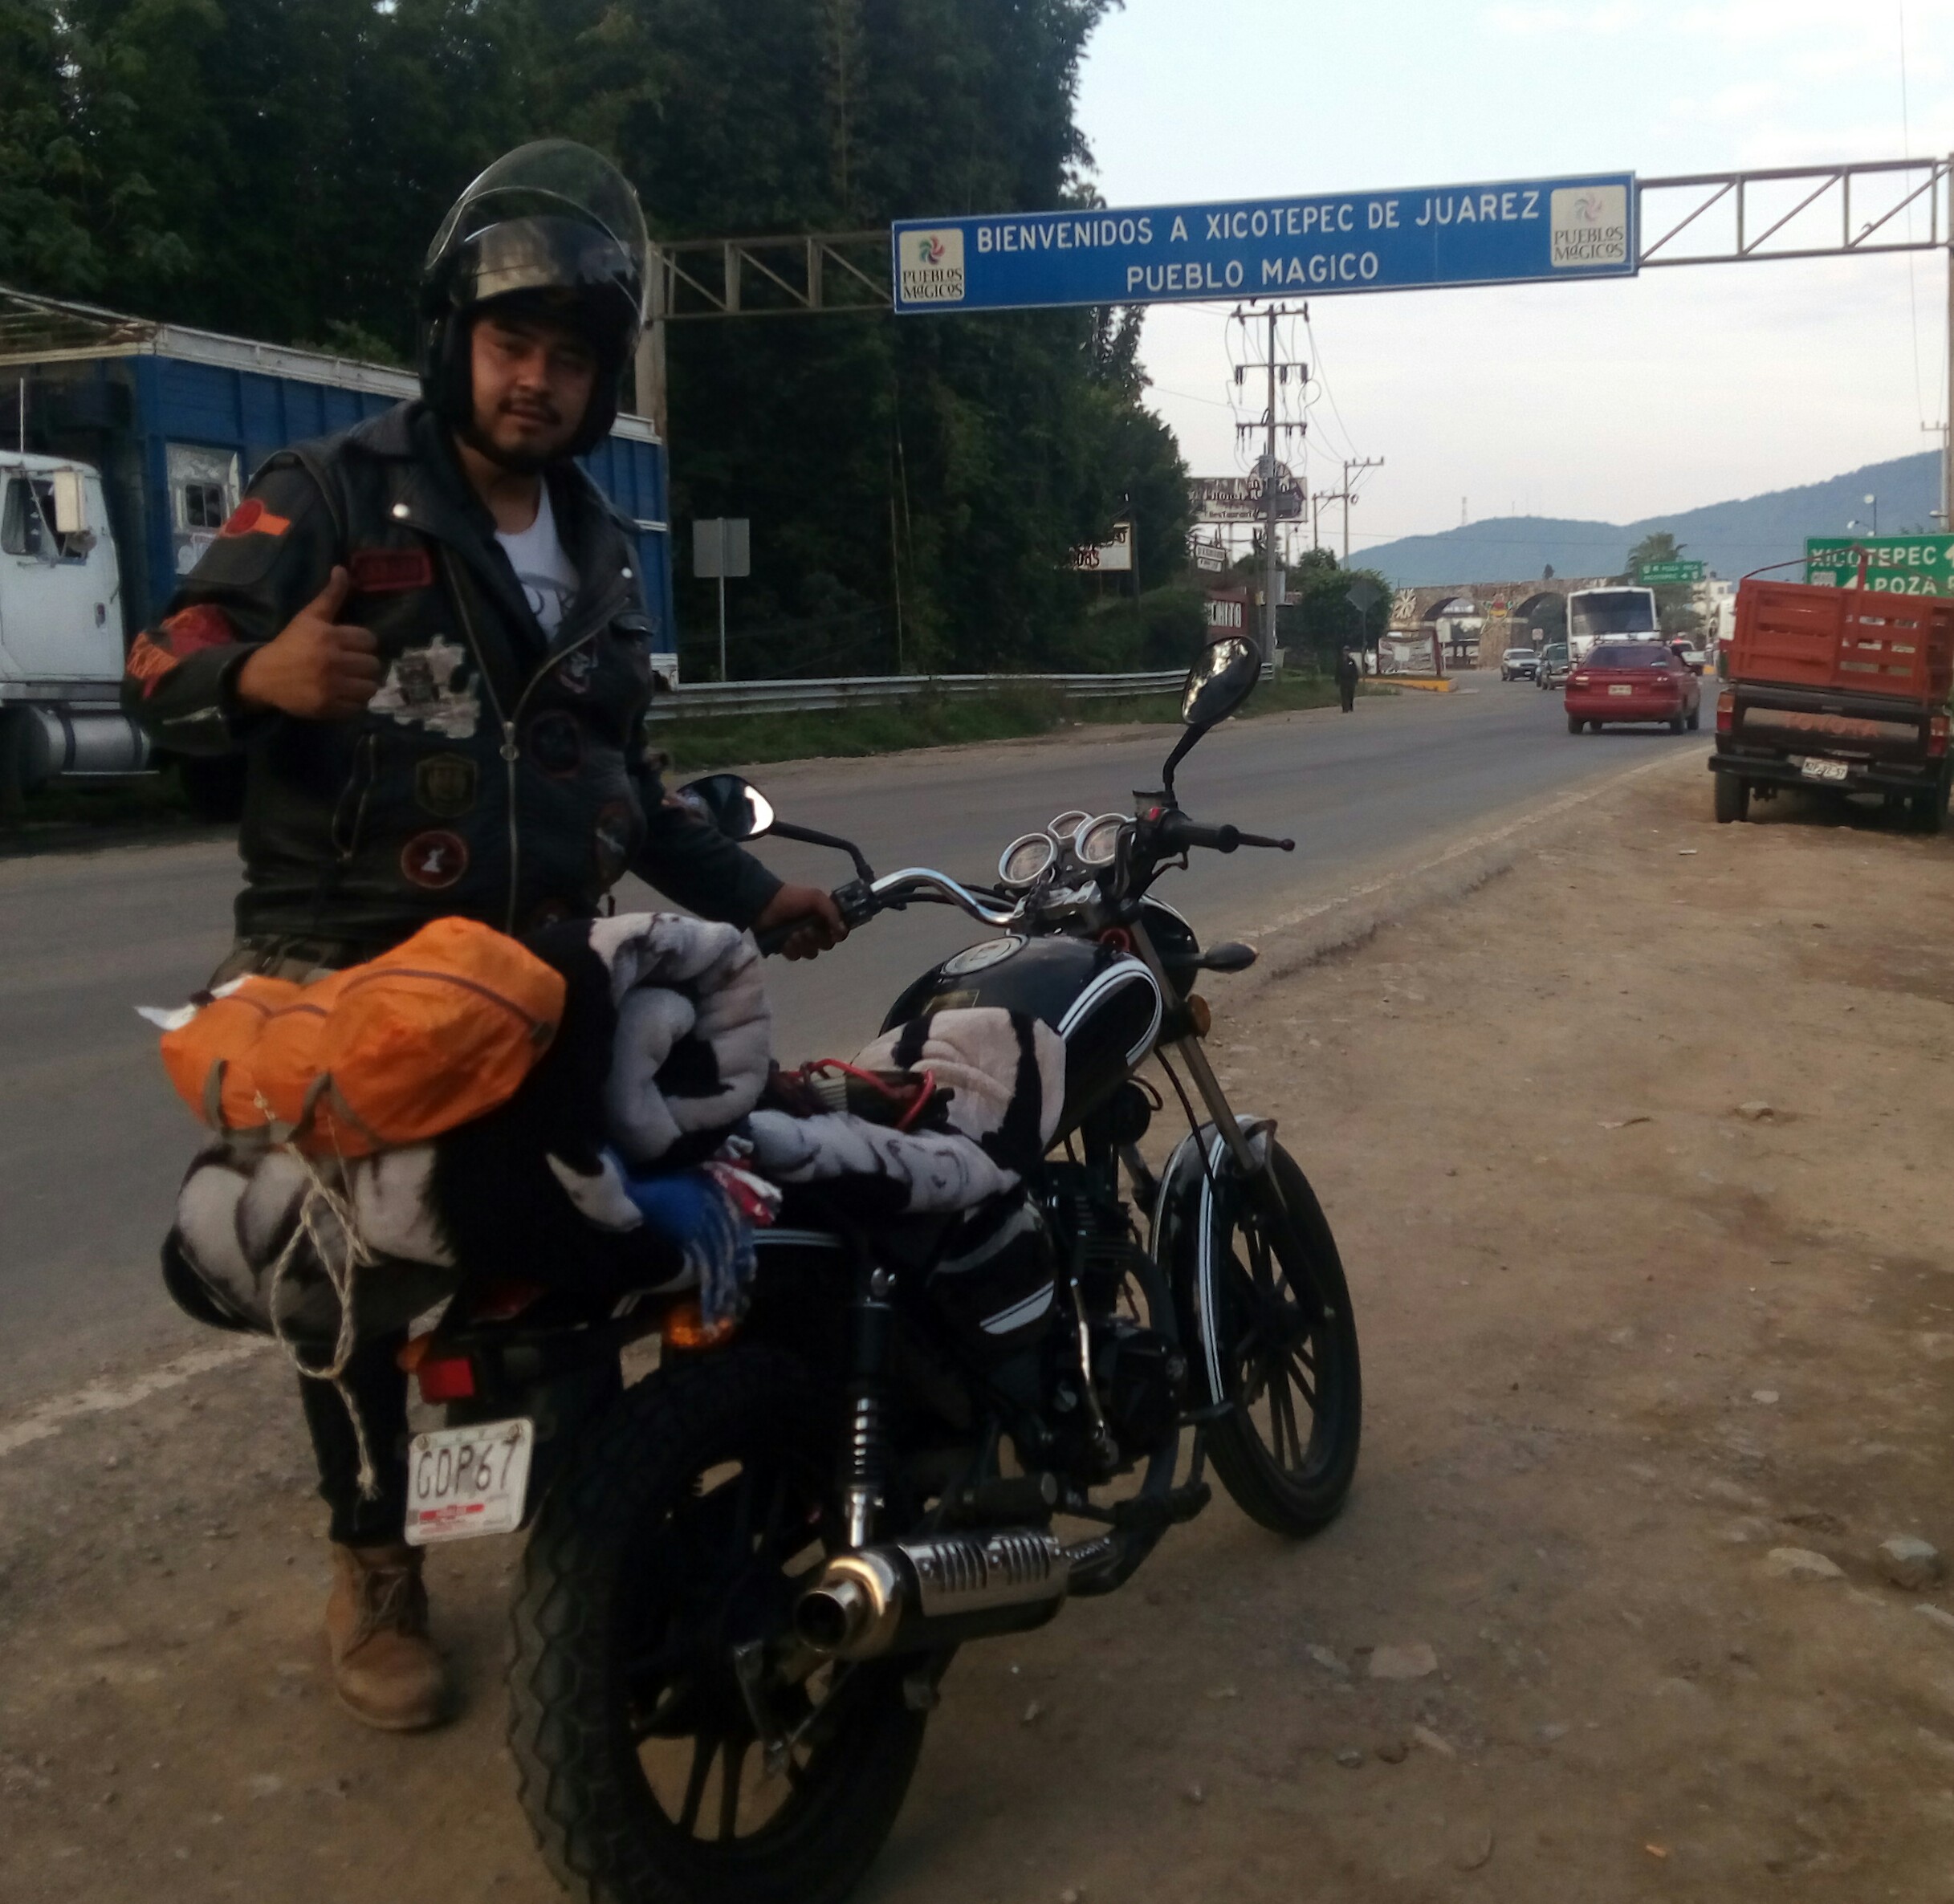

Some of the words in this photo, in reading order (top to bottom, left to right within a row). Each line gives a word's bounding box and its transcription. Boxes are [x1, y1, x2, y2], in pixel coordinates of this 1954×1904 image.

[977, 218, 1154, 254] BIENVENIDOS
[1170, 216, 1189, 242] A
[1206, 204, 1354, 240] XICOTEPEC
[1368, 201, 1400, 230] DE
[1415, 191, 1540, 227] JUAREZ
[1126, 260, 1244, 292] PUEBLO
[1262, 252, 1379, 285] MAGICO
[1810, 546, 1937, 568] XICOTEPEC
